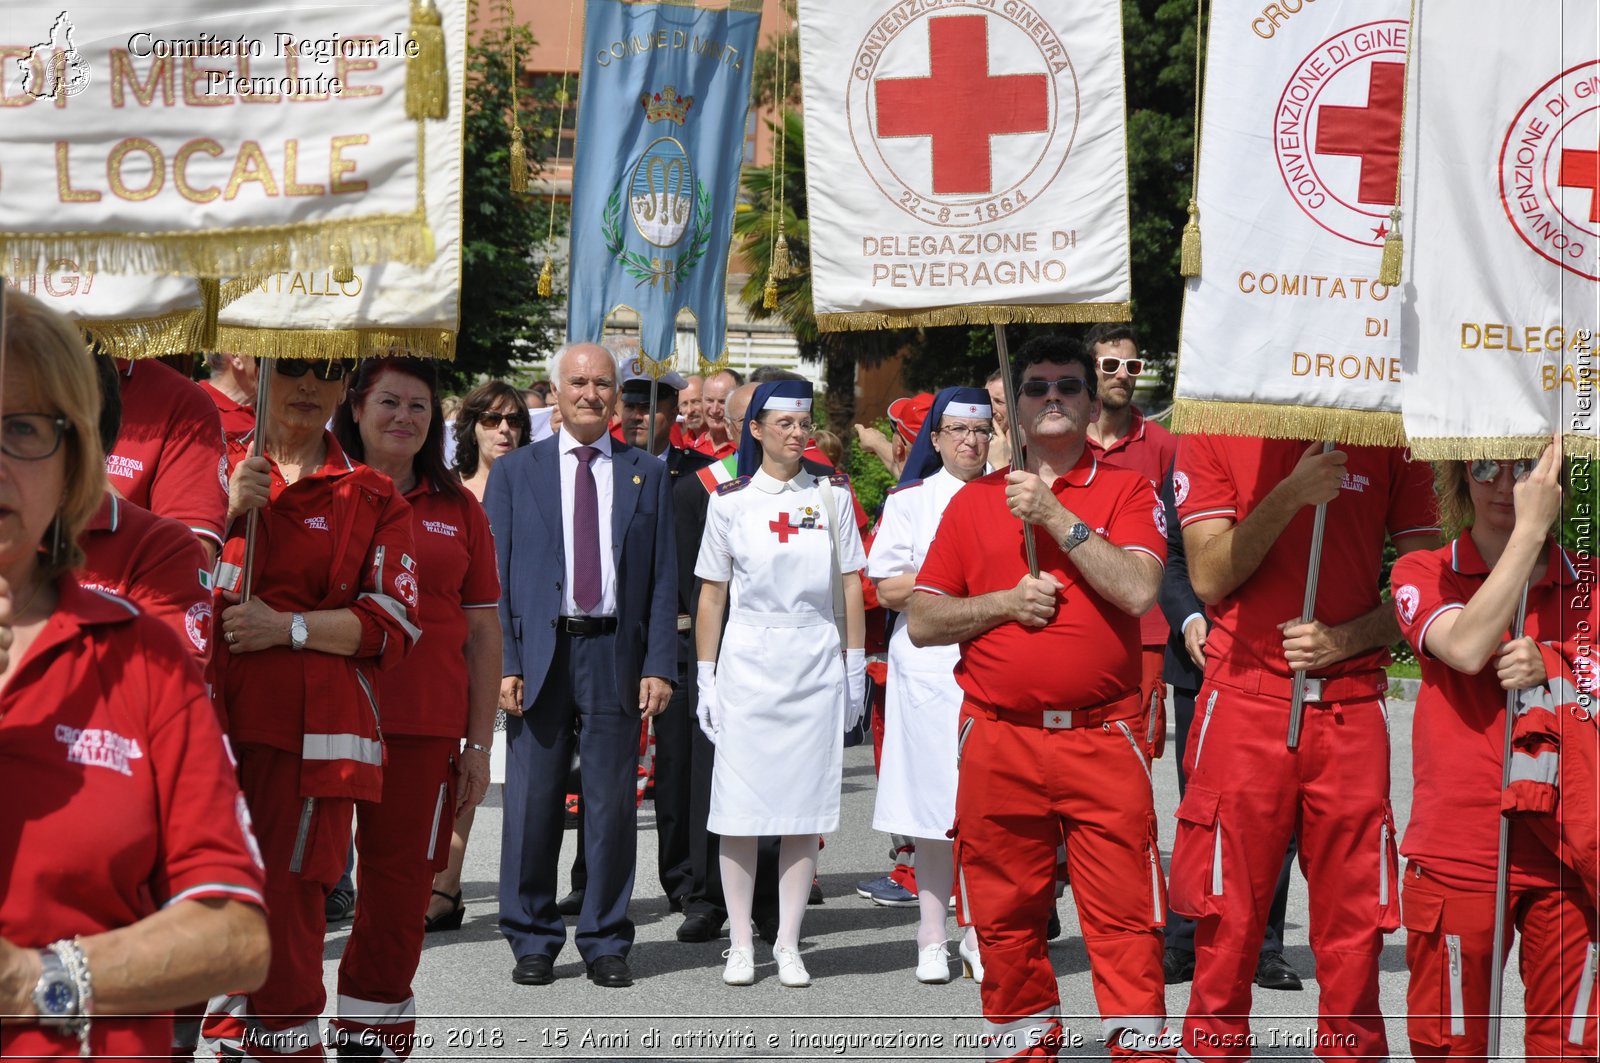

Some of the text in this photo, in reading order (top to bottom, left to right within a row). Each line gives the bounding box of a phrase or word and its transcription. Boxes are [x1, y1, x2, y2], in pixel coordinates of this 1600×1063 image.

[1251, 0, 1316, 39] CRO
[596, 29, 744, 74] COMUNE DI MNTA
[855, 0, 966, 81] CONVENZIO
[1003, 0, 1068, 76] GINEVRA
[0, 45, 66, 110] DI
[109, 35, 384, 109] MELLE
[1281, 28, 1407, 209] CONVENZIONE DI GINE
[1545, 93, 1570, 117] DI
[55, 134, 371, 203] LOCALE
[1515, 117, 1584, 258] CONVENZIONE
[863, 230, 1077, 257] DELEGAZIONE DI
[872, 260, 1067, 288] PEVERAGNO
[1239, 271, 1389, 301] COMITATO
[1365, 317, 1388, 337] DI
[1291, 352, 1400, 383] DRONE
[119, 456, 143, 471] ROSSA
